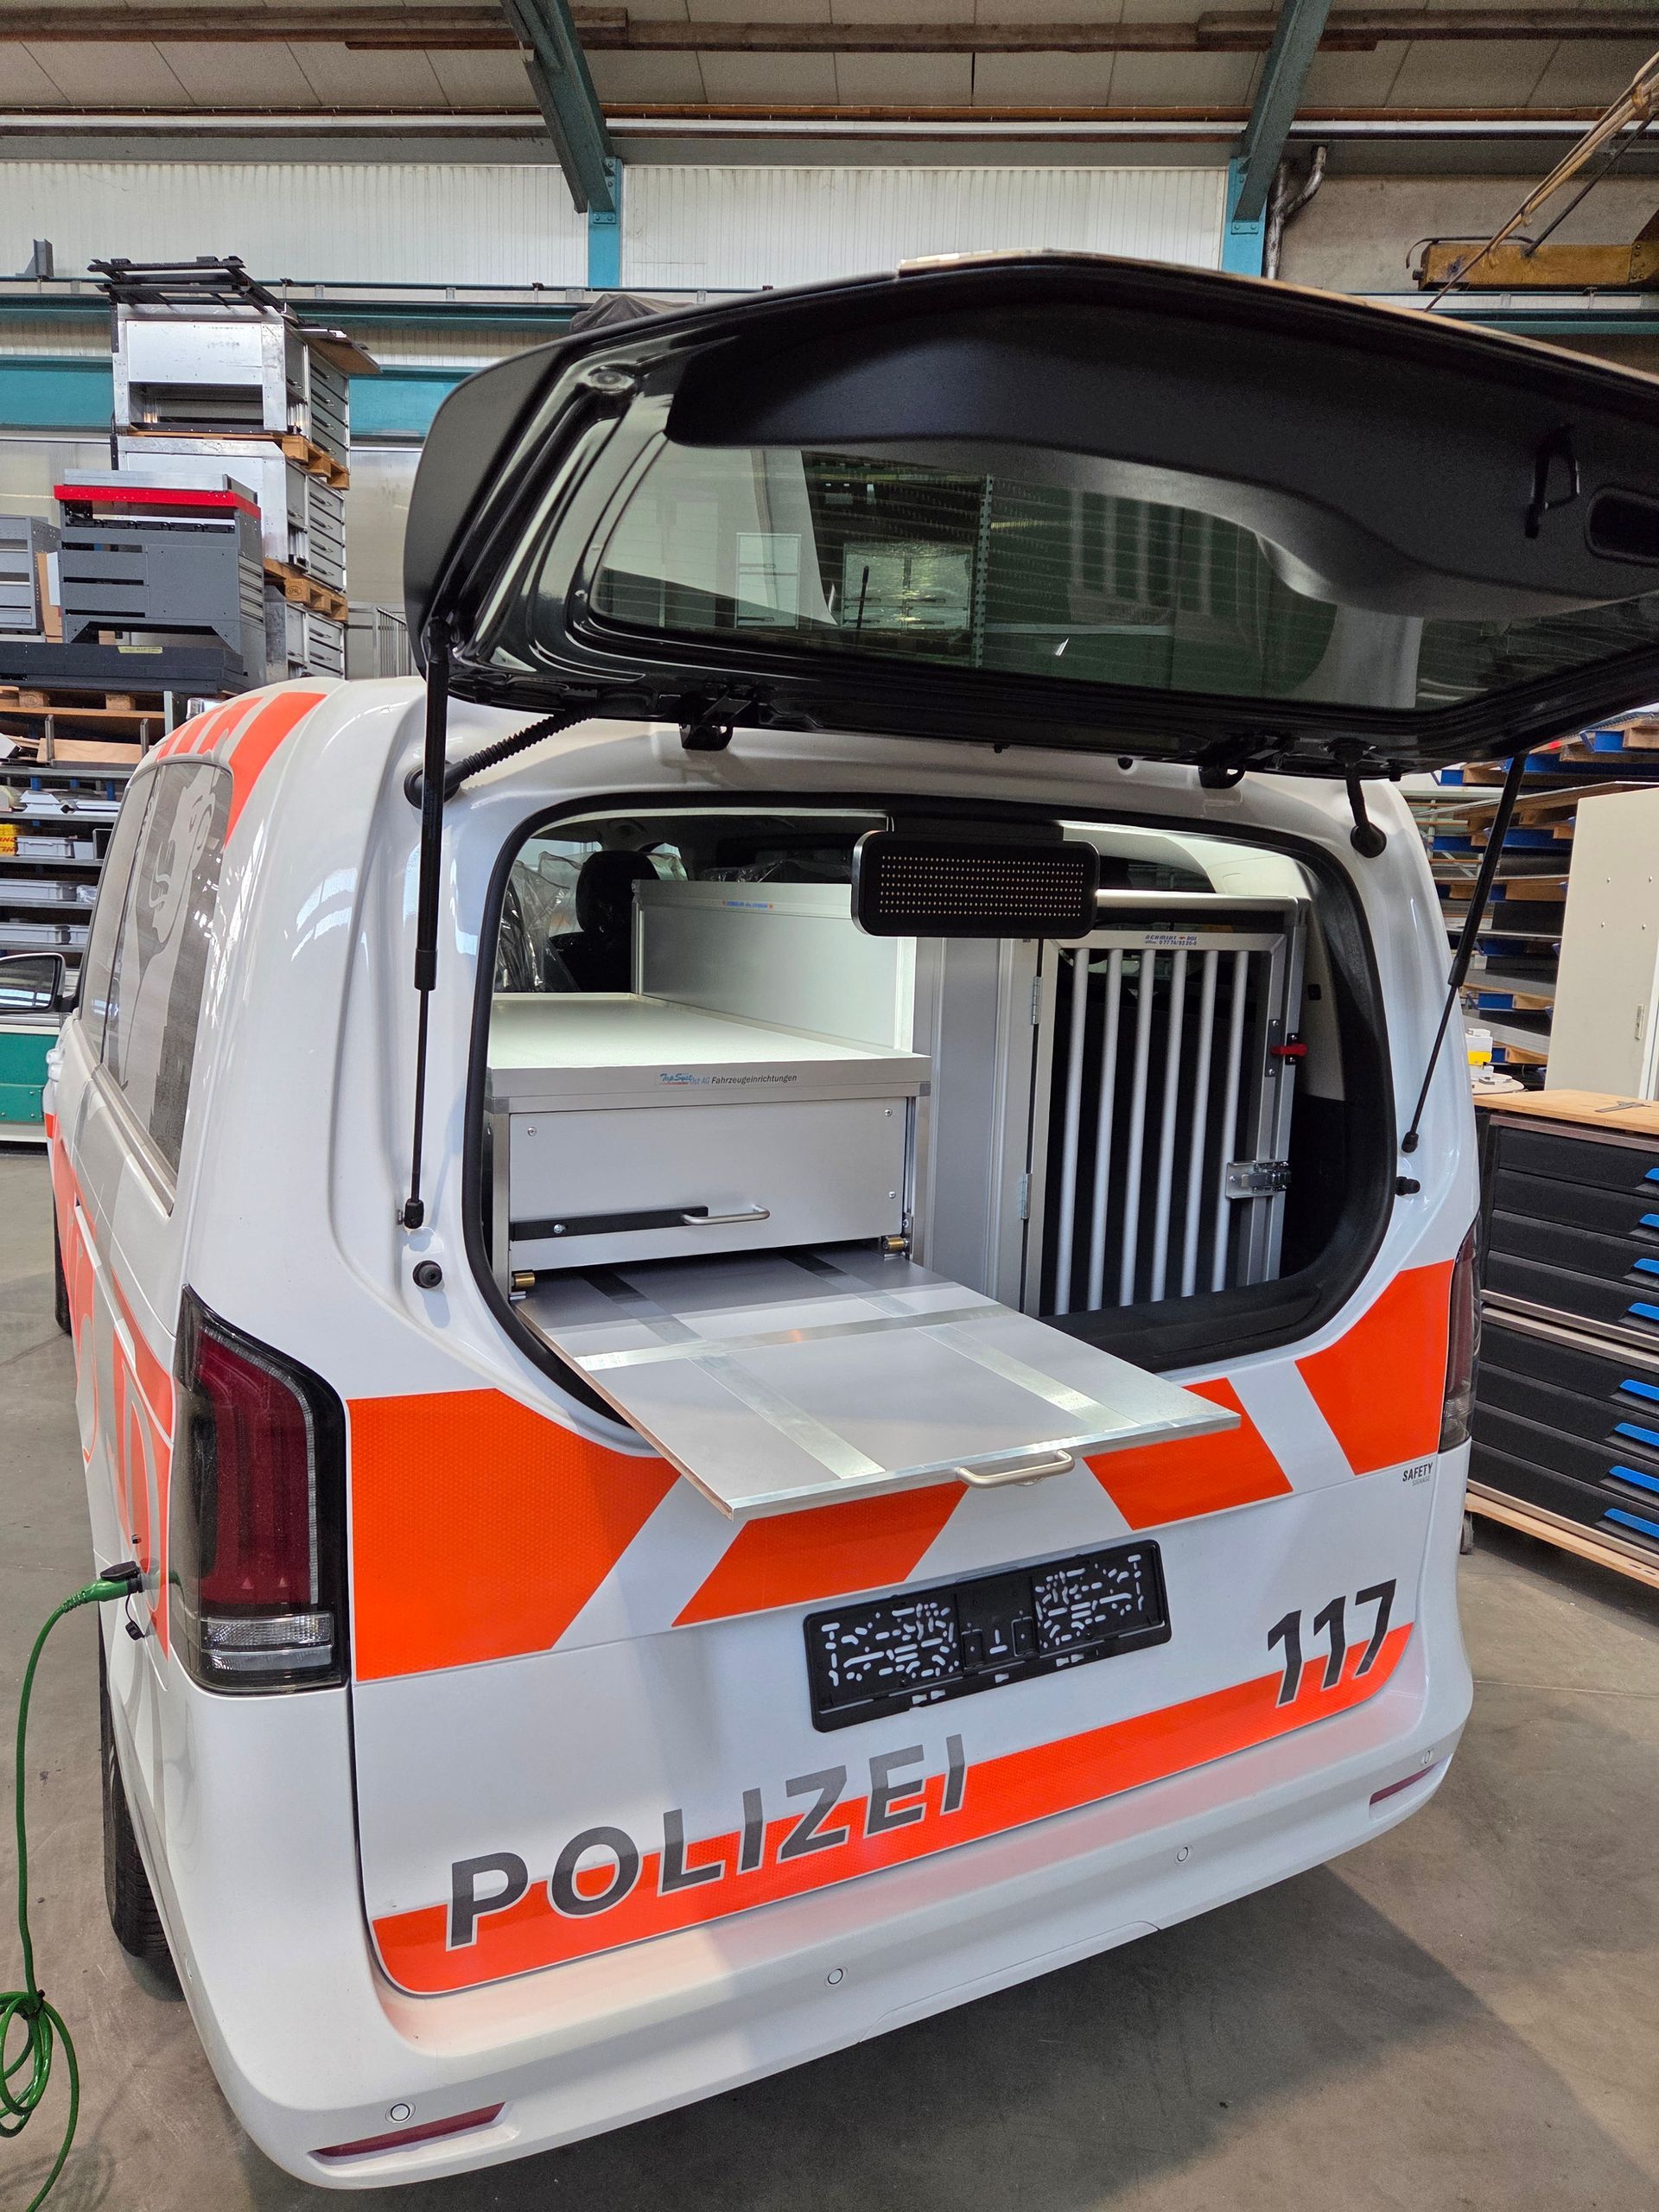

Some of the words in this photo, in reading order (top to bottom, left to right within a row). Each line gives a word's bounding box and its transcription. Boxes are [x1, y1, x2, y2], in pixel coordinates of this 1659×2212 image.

[711, 1075, 798, 1085] Fahrzeugeinrichtungen
[1402, 1461, 1433, 1482] SAFETY
[1267, 1578, 1397, 1706] 117
[448, 1732, 965, 1950] POLIZEI
